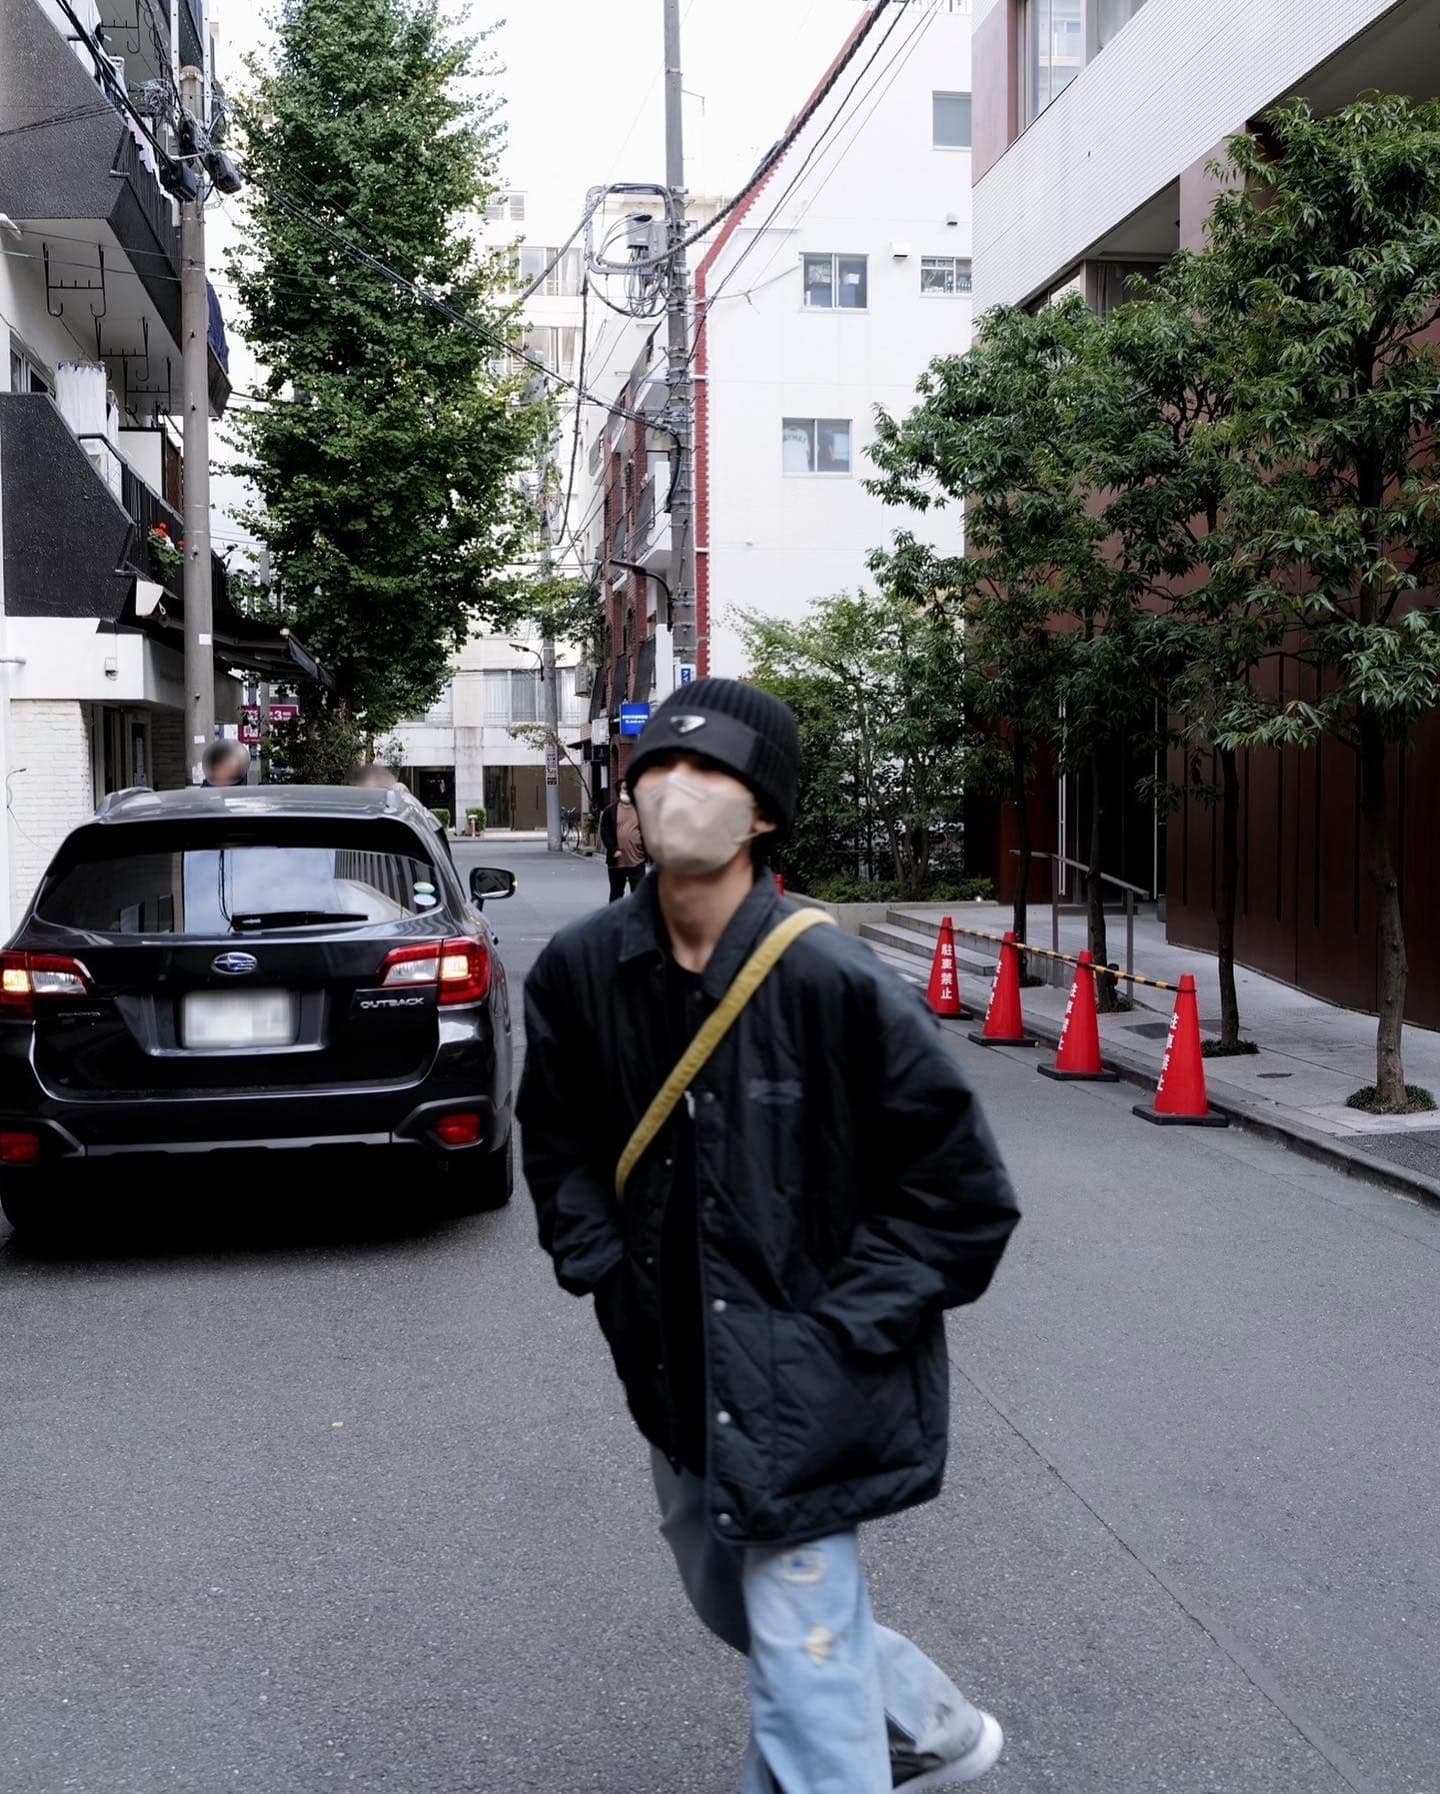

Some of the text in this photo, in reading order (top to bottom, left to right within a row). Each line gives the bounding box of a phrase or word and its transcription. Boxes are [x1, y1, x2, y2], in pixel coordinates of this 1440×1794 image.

[940, 943, 953, 1000] 駐車禁止
[360, 997, 425, 1009] OUTBACK
